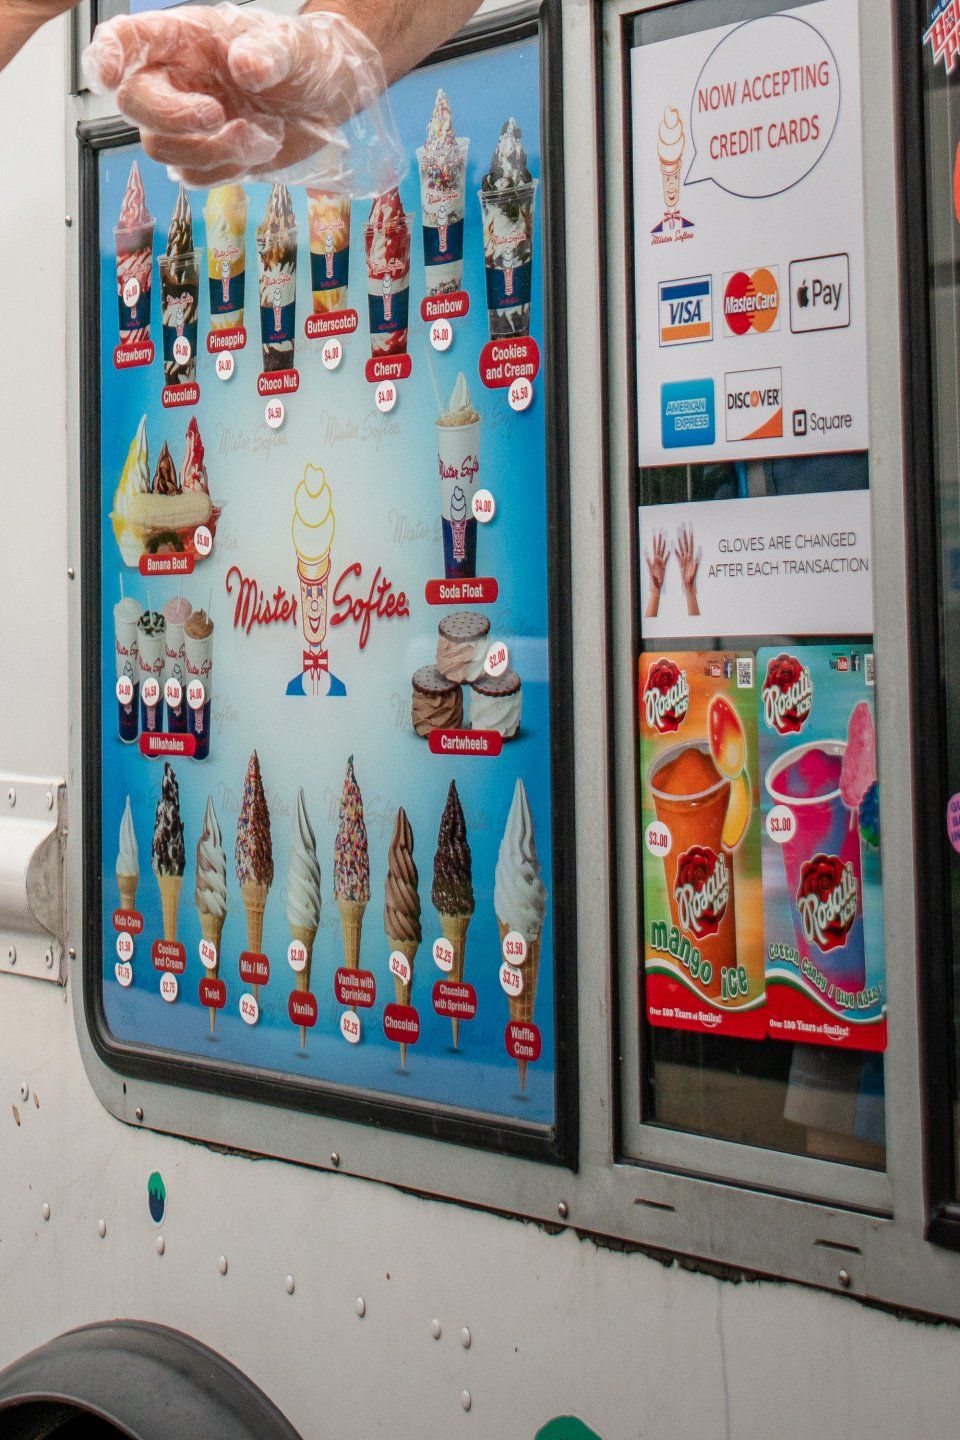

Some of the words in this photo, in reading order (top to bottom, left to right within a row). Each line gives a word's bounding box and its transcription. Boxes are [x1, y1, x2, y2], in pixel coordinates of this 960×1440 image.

[698, 81, 737, 113] NOW
[741, 61, 829, 103] ACCEPTING
[709, 126, 763, 160] CREDIT
[767, 115, 820, 148] CARDS
[725, 293, 778, 314] MasterCard
[812, 279, 842, 311] Pay
[426, 299, 462, 316] Rainbow
[669, 299, 702, 325] VISA
[307, 313, 357, 335] Butterscotch
[209, 332, 244, 349] Pineapple
[432, 328, 449, 342] $4.00
[116, 346, 152, 363] Strawberry
[492, 344, 527, 362] Cookies
[374, 361, 402, 381] Cherry
[485, 366, 503, 380] and
[504, 362, 534, 378] Cream
[258, 377, 282, 392] Choco
[283, 374, 297, 390] Nut
[163, 387, 197, 404] Chocolate
[511, 385, 528, 404] $4.50
[727, 389, 779, 410] DISCOVER
[666, 398, 706, 415] AMERICAN
[675, 414, 709, 430] EXPRESS
[810, 413, 852, 436] Square
[718, 537, 765, 553] GLOVES
[768, 535, 791, 551] ARE
[795, 532, 856, 549] CHANGED
[147, 558, 171, 571] Banana
[172, 557, 187, 570] Boat
[708, 562, 743, 578] AFTER
[747, 560, 779, 576] EACH
[782, 557, 869, 575] TRANSACTION
[439, 584, 460, 599] Soda
[461, 583, 483, 598] Float
[226, 565, 298, 635] Mister
[330, 562, 410, 650] Softee
[645, 668, 689, 728] Rosati
[762, 666, 813, 728] Rosati
[796, 696, 812, 715] ICE
[674, 697, 689, 716] ICE
[149, 736, 184, 751] Milkshakes
[440, 734, 488, 751] Cartwheels
[770, 817, 791, 832] $3.00
[648, 832, 668, 848] $3.00
[674, 853, 728, 932] Rosati
[713, 887, 729, 914] ICE
[798, 861, 856, 946] Rosati
[840, 897, 857, 925] ICE
[114, 914, 126, 926] Kids
[157, 943, 179, 956] Cookies
[506, 941, 523, 955] $3.50
[154, 957, 165, 967] and
[241, 960, 252, 973] Mix
[256, 962, 268, 975] Mix
[337, 972, 359, 987] Vanilla
[360, 975, 374, 989] with
[204, 987, 219, 1000] Twist
[341, 988, 371, 1003] Sprinkles
[439, 984, 468, 998] Chocolate
[292, 1002, 314, 1016] Vanilla
[434, 999, 447, 1009] with
[447, 1000, 474, 1014] Sprinkles
[674, 1008, 692, 1019] Years
[384, 1015, 418, 1032] Chocolate
[796, 1020, 816, 1032] Years
[510, 1026, 535, 1042] Waffle
[514, 1043, 534, 1057] Cone
